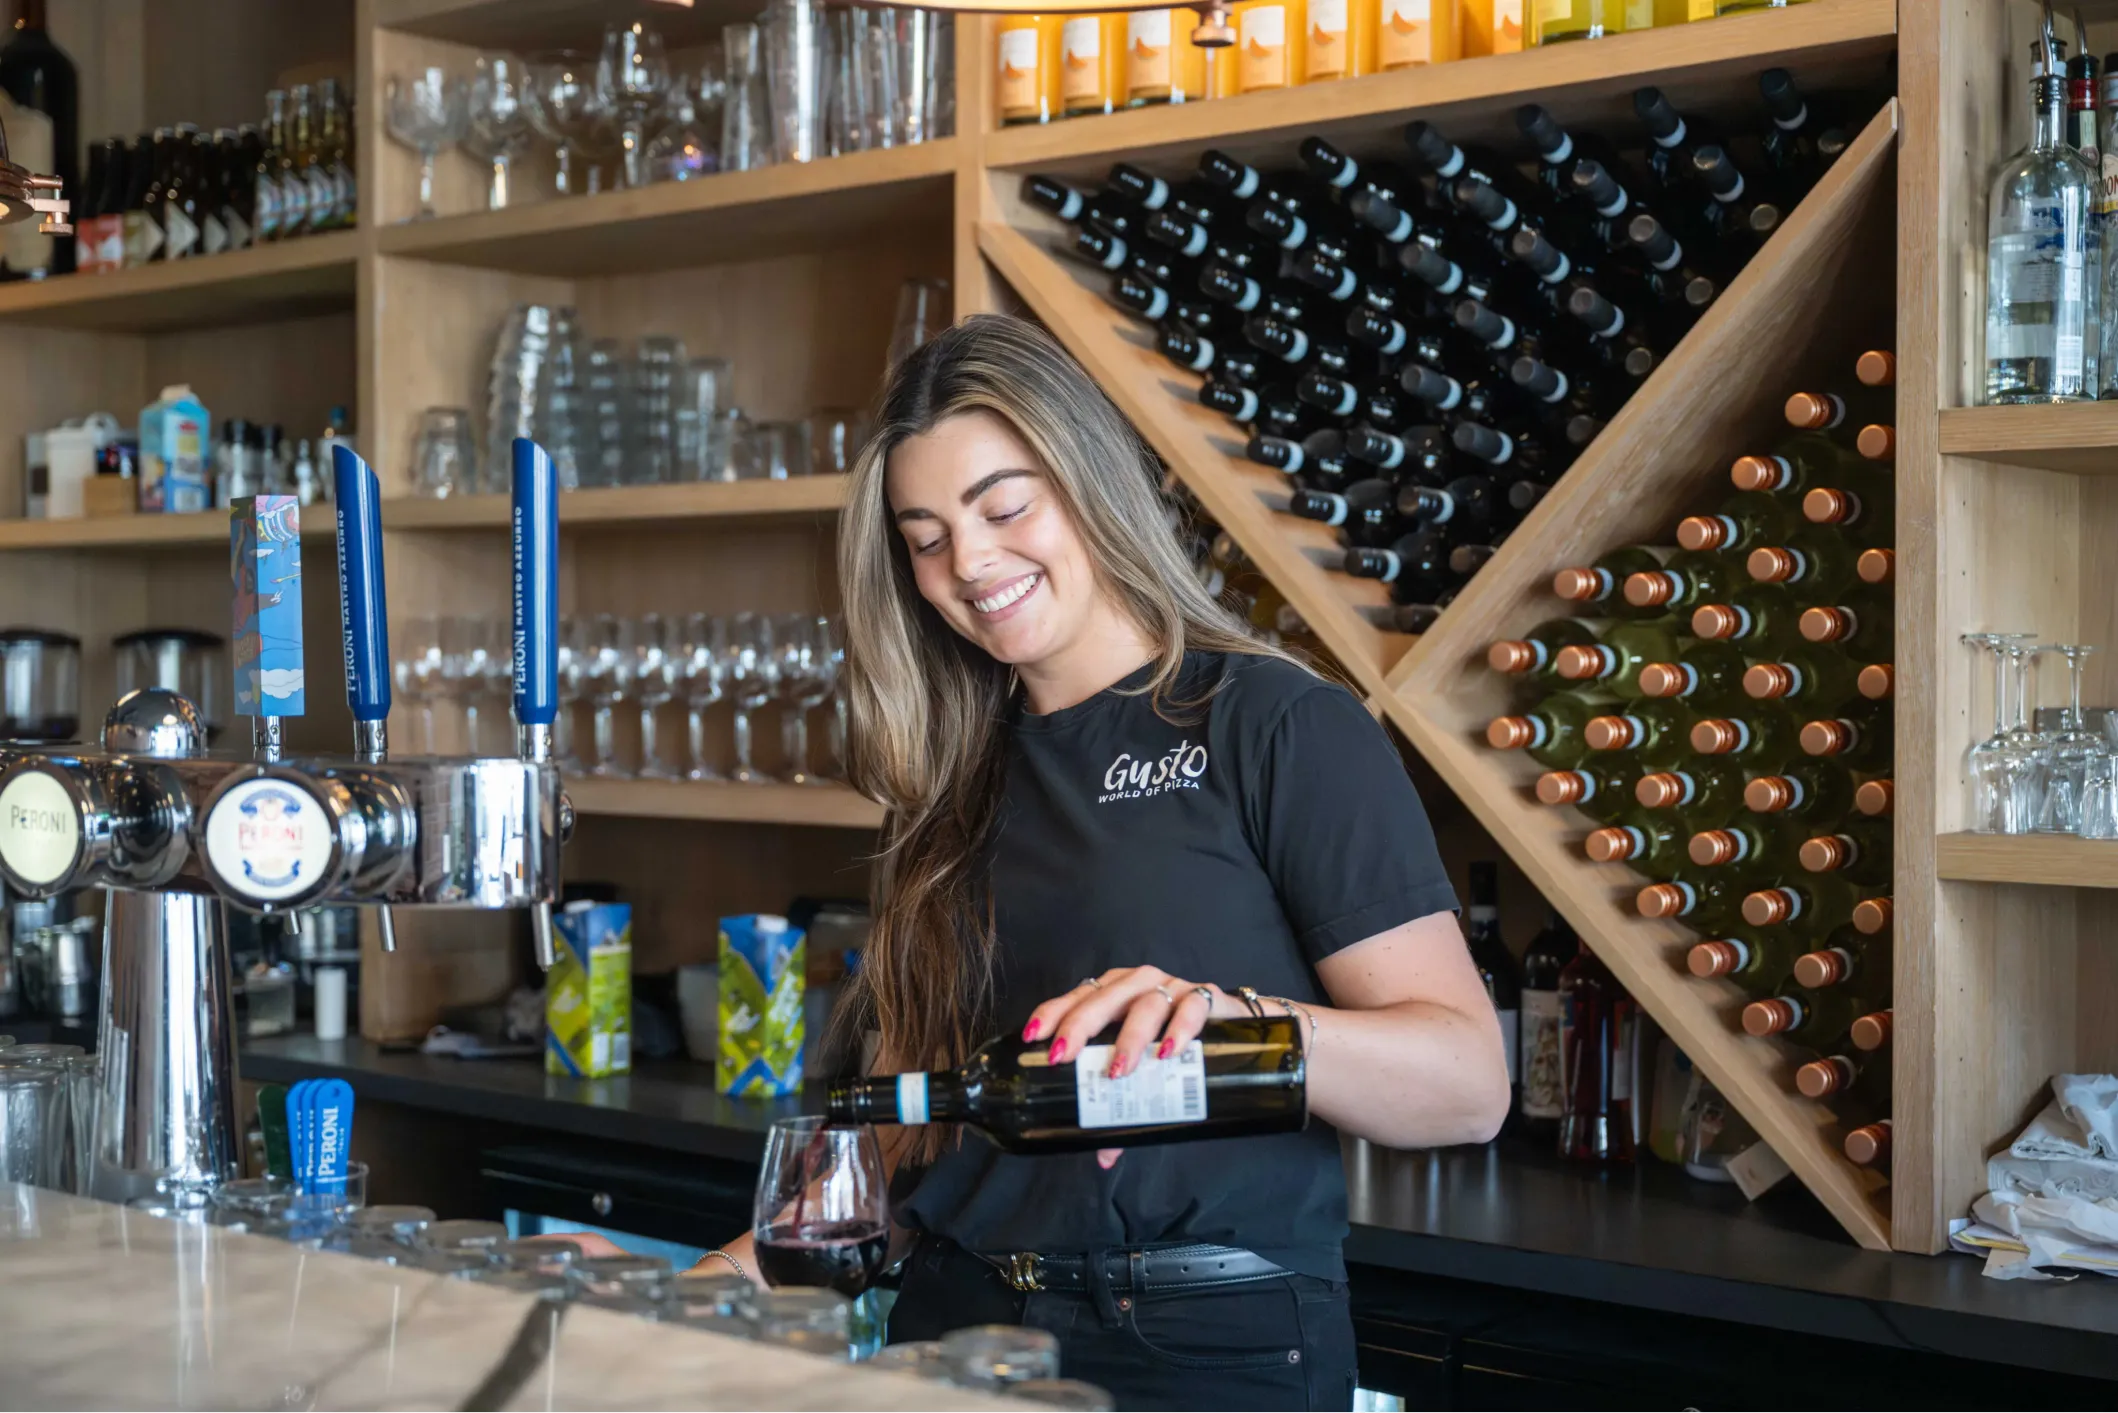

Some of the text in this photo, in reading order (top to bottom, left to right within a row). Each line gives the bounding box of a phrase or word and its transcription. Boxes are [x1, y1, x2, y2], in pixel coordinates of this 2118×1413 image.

[338, 510, 357, 692] PERONI NASTRO AZZURRO
[514, 506, 527, 695] PERONI NASTRO AZZURRO
[11, 804, 67, 834] PERONI
[1098, 778, 1200, 804] WORLD OF PIZZA
[318, 1106, 339, 1176] PERONI
